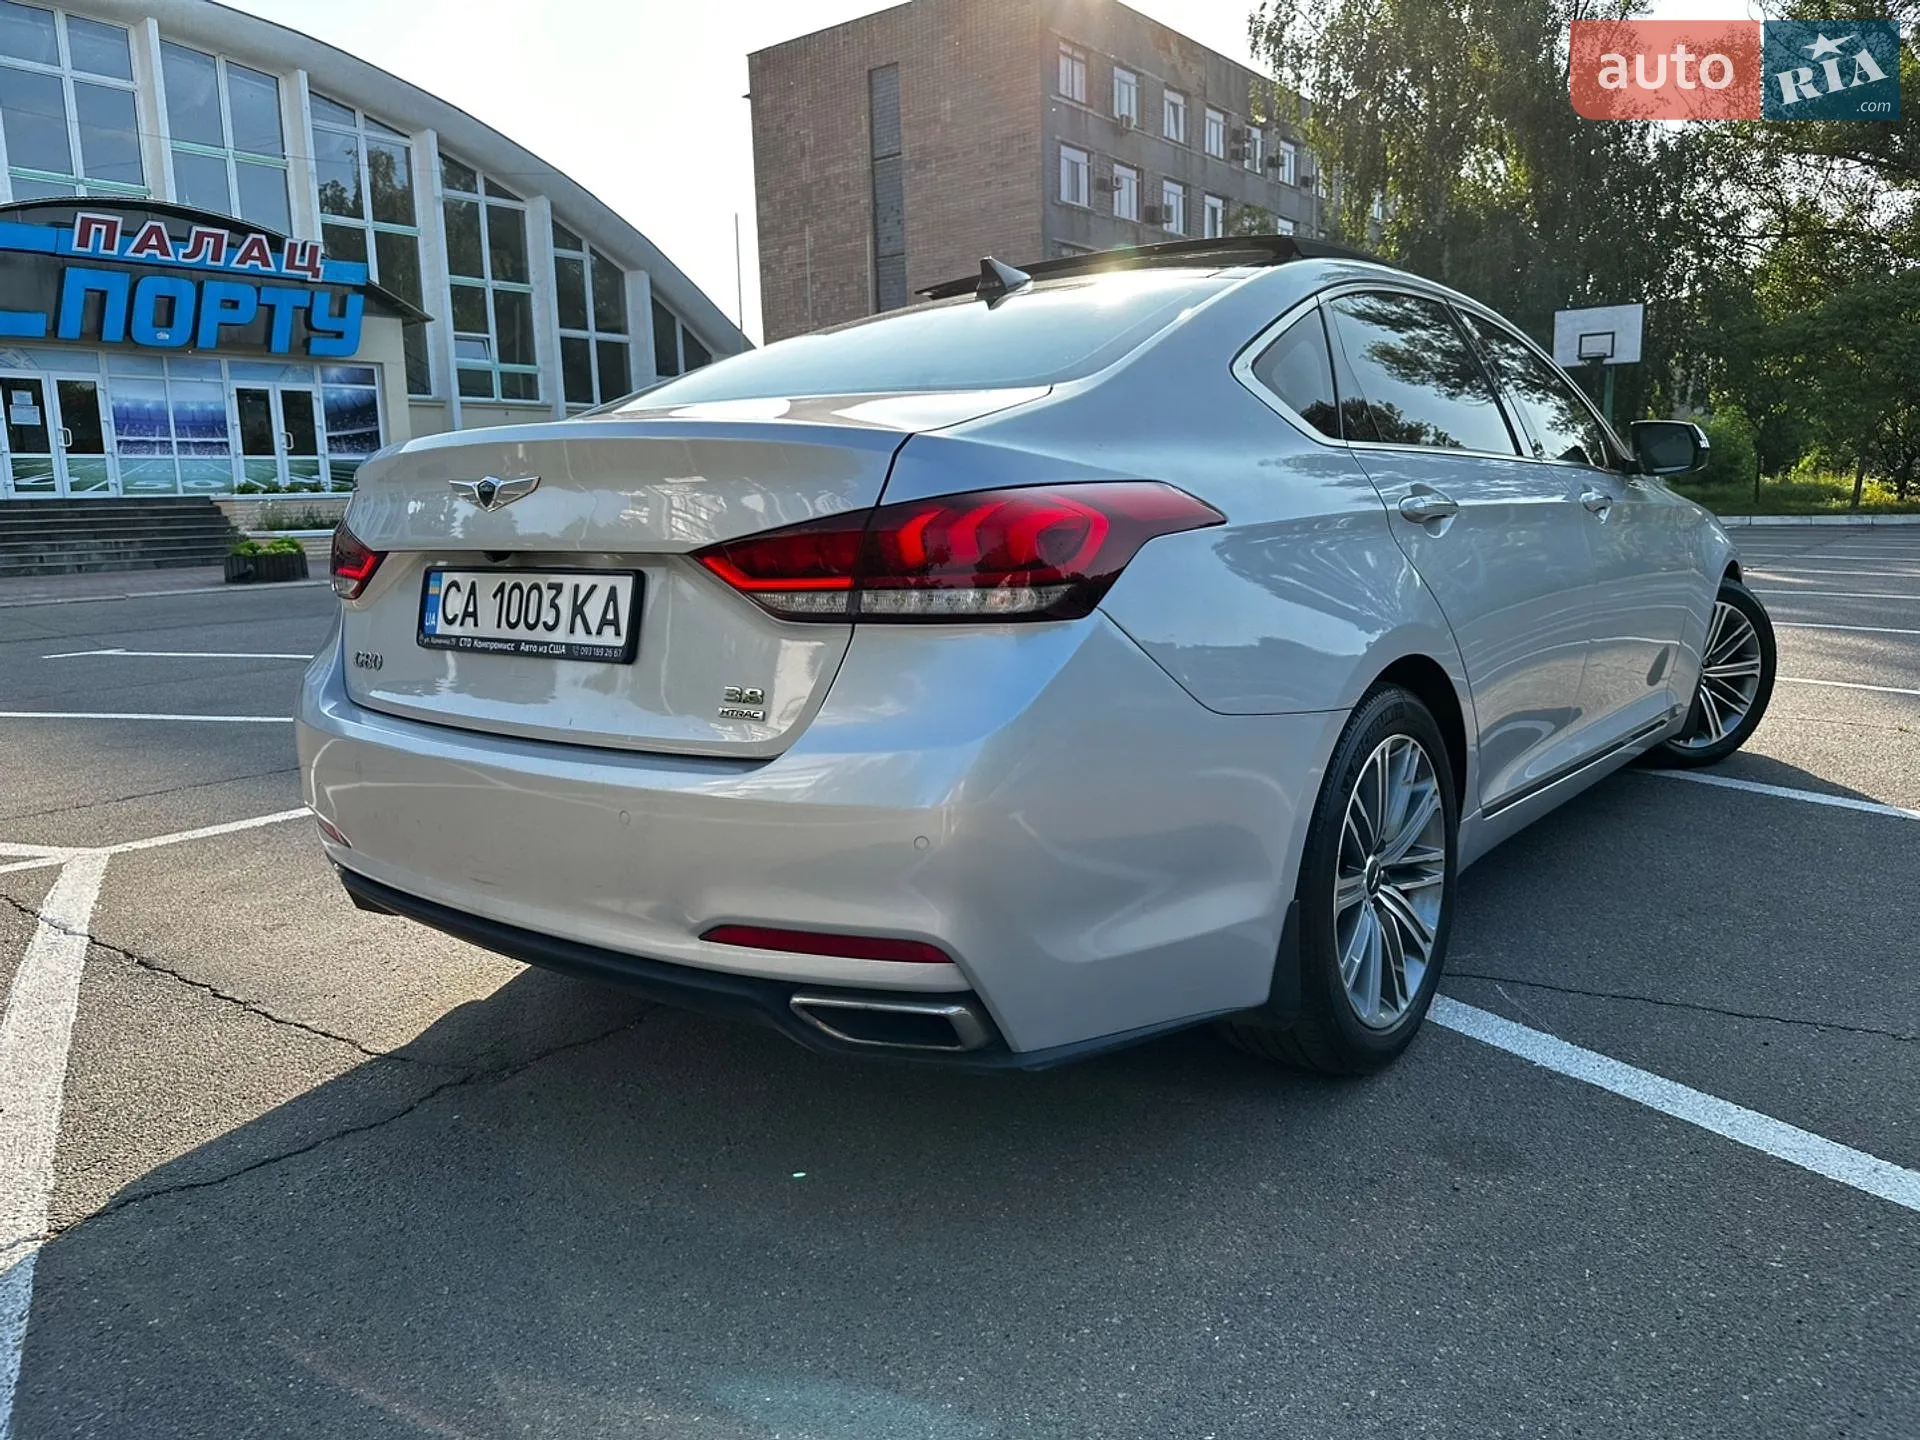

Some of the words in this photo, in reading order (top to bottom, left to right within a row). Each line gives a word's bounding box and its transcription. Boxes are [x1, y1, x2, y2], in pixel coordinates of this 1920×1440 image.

[71, 210, 325, 283] ПАЛАЦ
[442, 579, 479, 627] CA
[492, 581, 564, 632] 1003
[569, 583, 621, 637] KA
[425, 612, 436, 626] UA
[355, 651, 384, 671] G80
[719, 709, 760, 719] HTRAC
